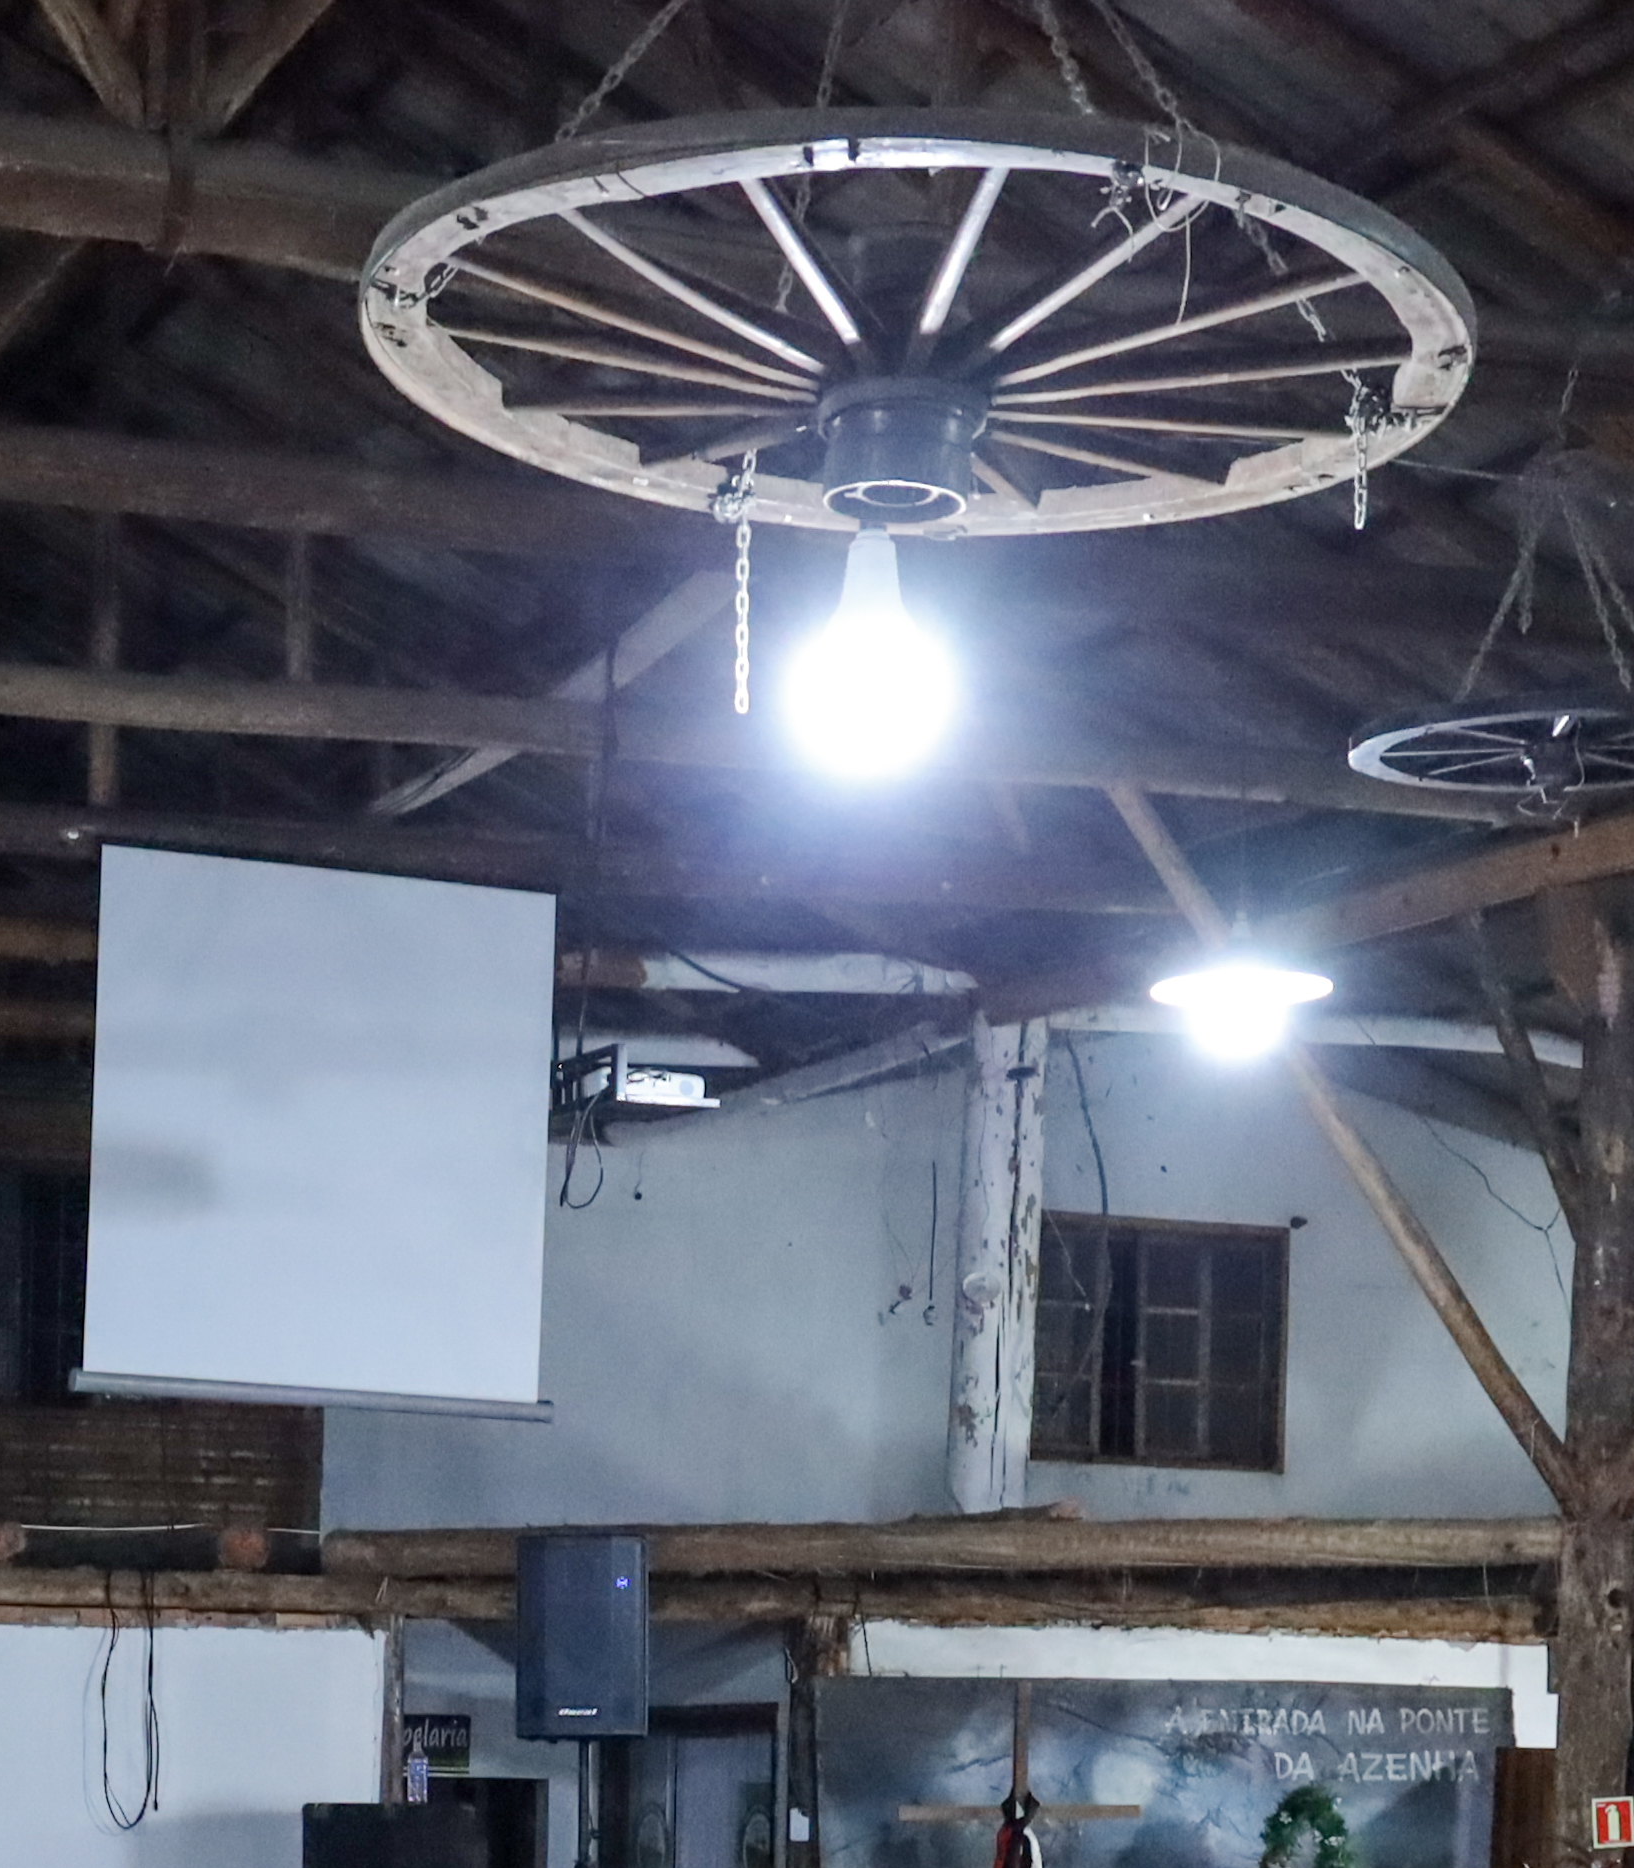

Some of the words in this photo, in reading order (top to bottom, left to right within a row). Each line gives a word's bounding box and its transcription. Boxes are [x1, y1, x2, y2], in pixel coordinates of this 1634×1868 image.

[1200, 1707, 1327, 1736] ENTRADA
[1347, 1707, 1385, 1735] NA
[1399, 1707, 1490, 1735] PONTE
[1273, 1751, 1315, 1782] DA
[1337, 1749, 1479, 1783] AZENHA
